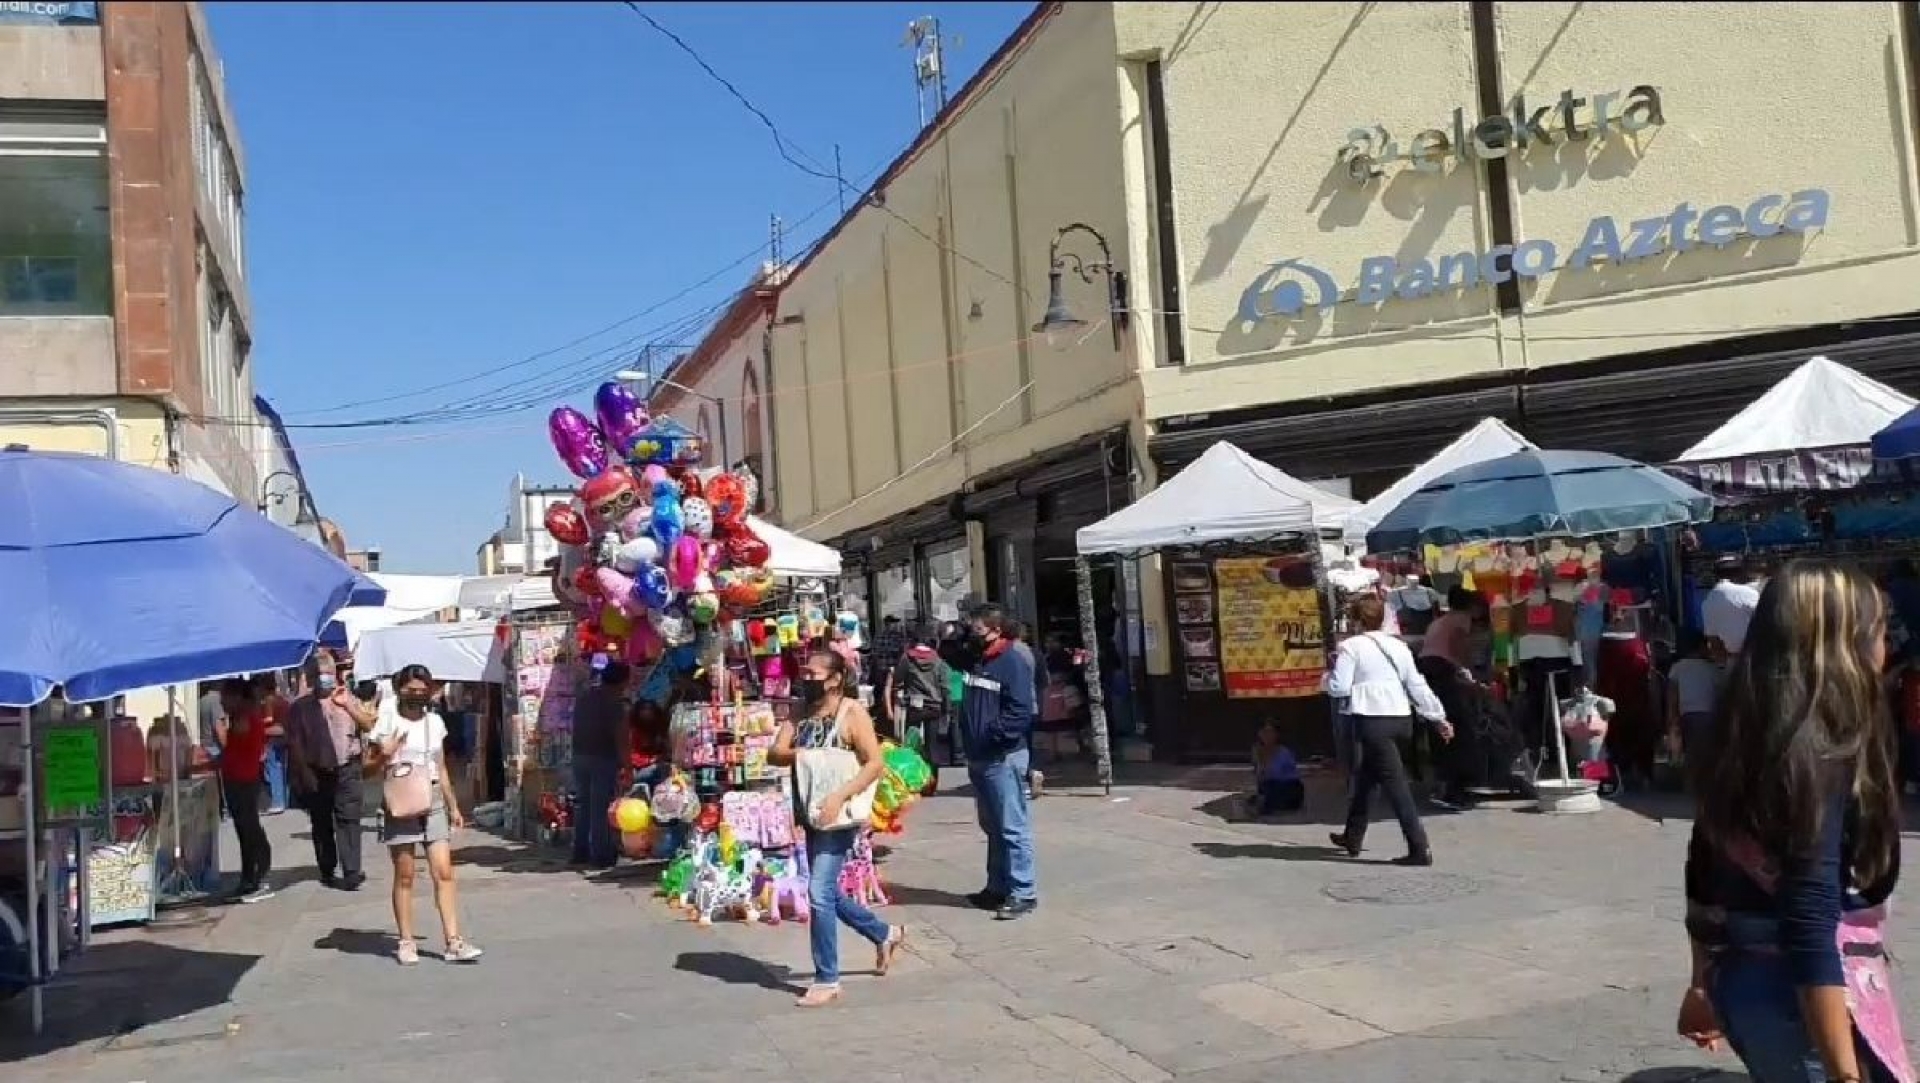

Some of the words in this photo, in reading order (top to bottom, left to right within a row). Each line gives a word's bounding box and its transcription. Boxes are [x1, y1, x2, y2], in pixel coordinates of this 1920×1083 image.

[1410, 84, 1665, 172] elektra
[1355, 237, 1557, 305] Banco
[1574, 188, 1831, 270] Azteca
[1698, 455, 1809, 491] PLATA
